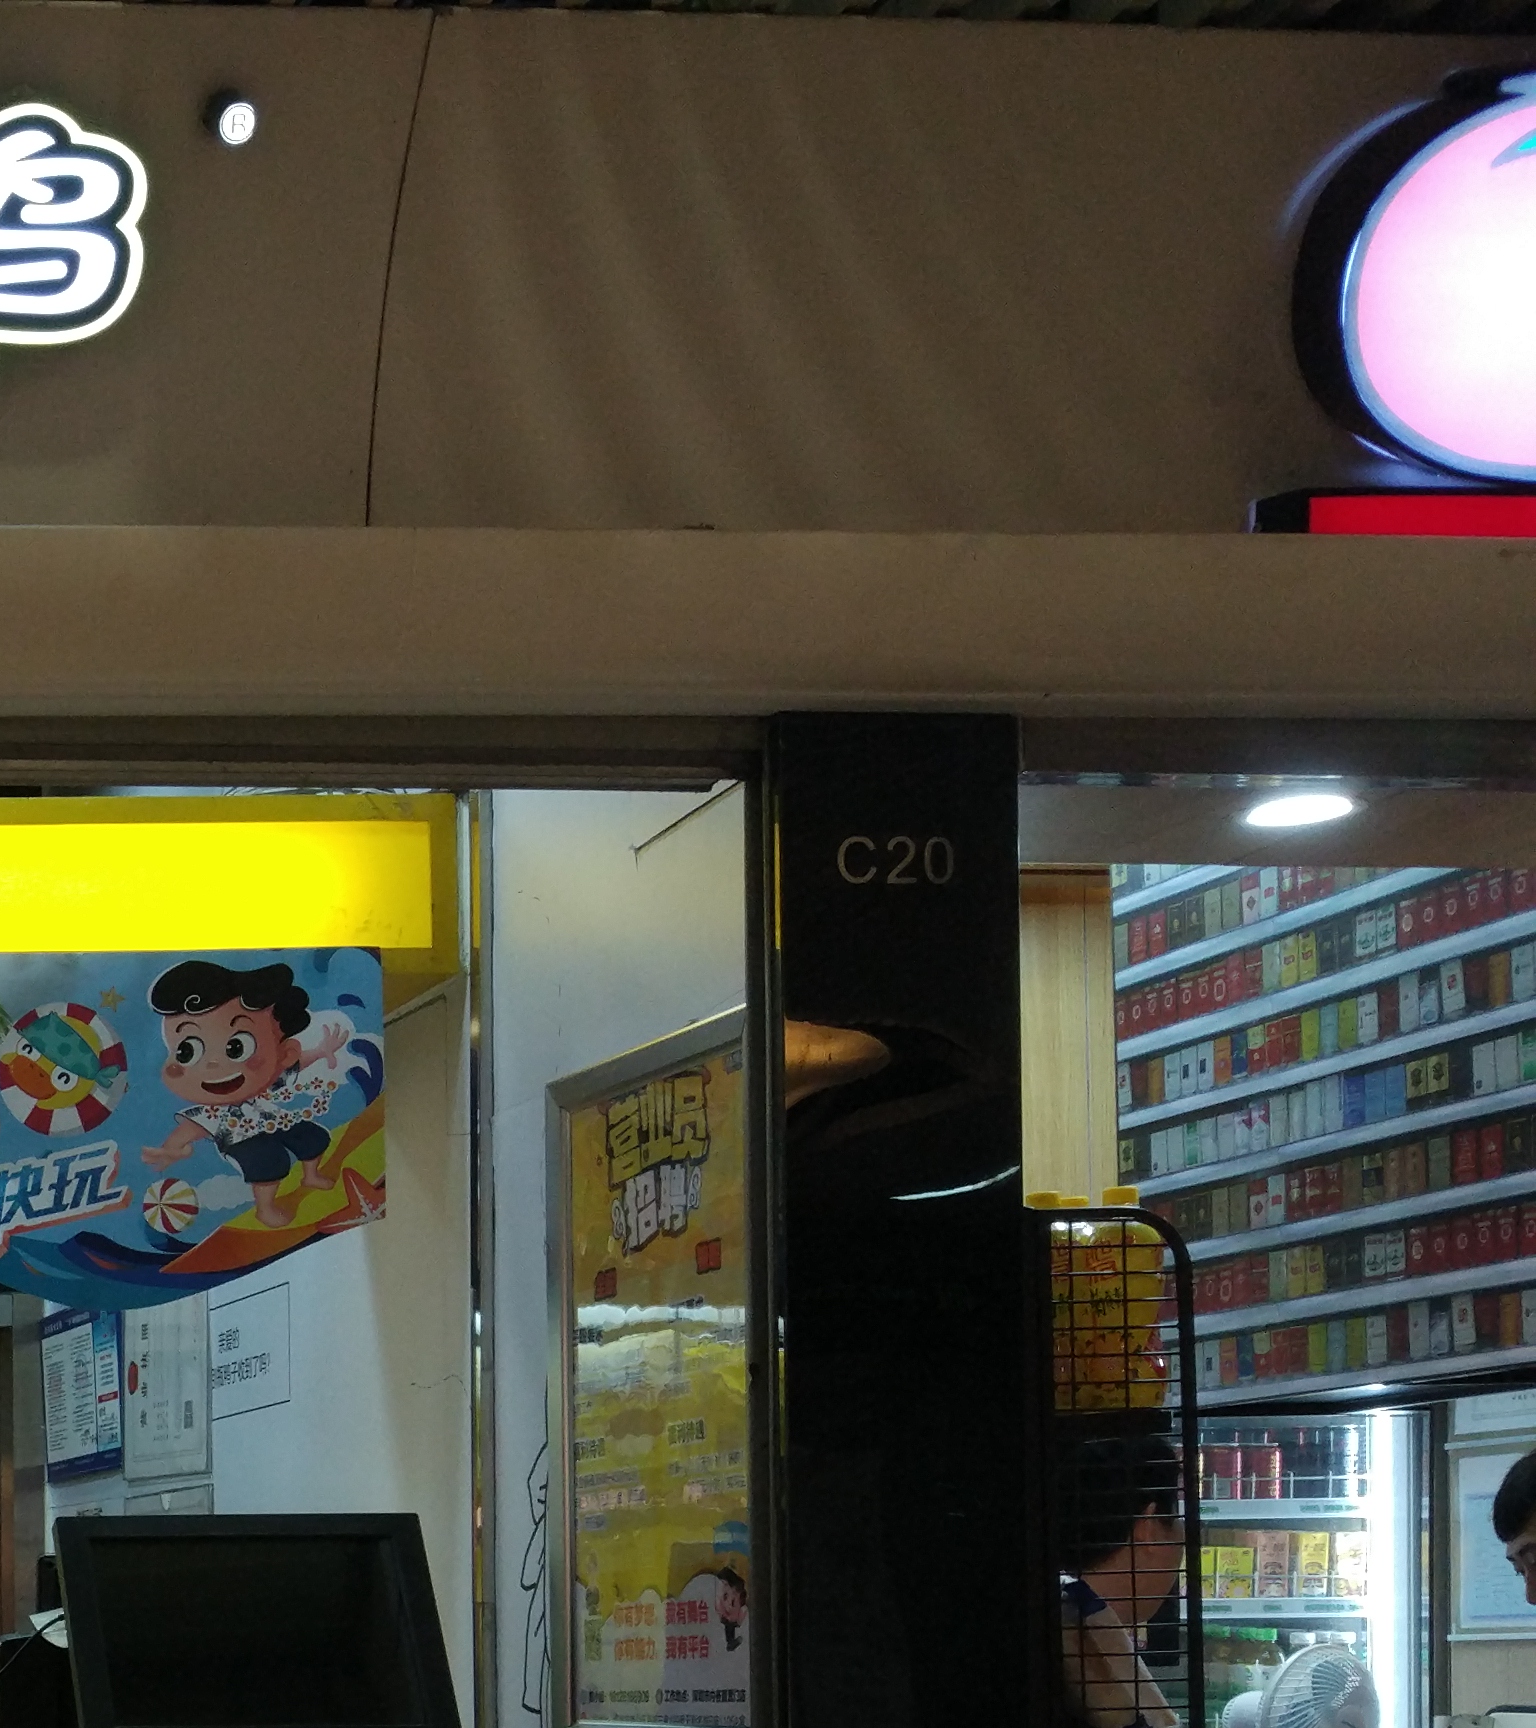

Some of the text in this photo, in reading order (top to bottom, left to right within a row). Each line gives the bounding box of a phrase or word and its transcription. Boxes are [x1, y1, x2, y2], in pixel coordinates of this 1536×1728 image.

[836, 836, 955, 887] C20
[608, 1073, 709, 1174] 营业员
[623, 1163, 691, 1250] 招聘
